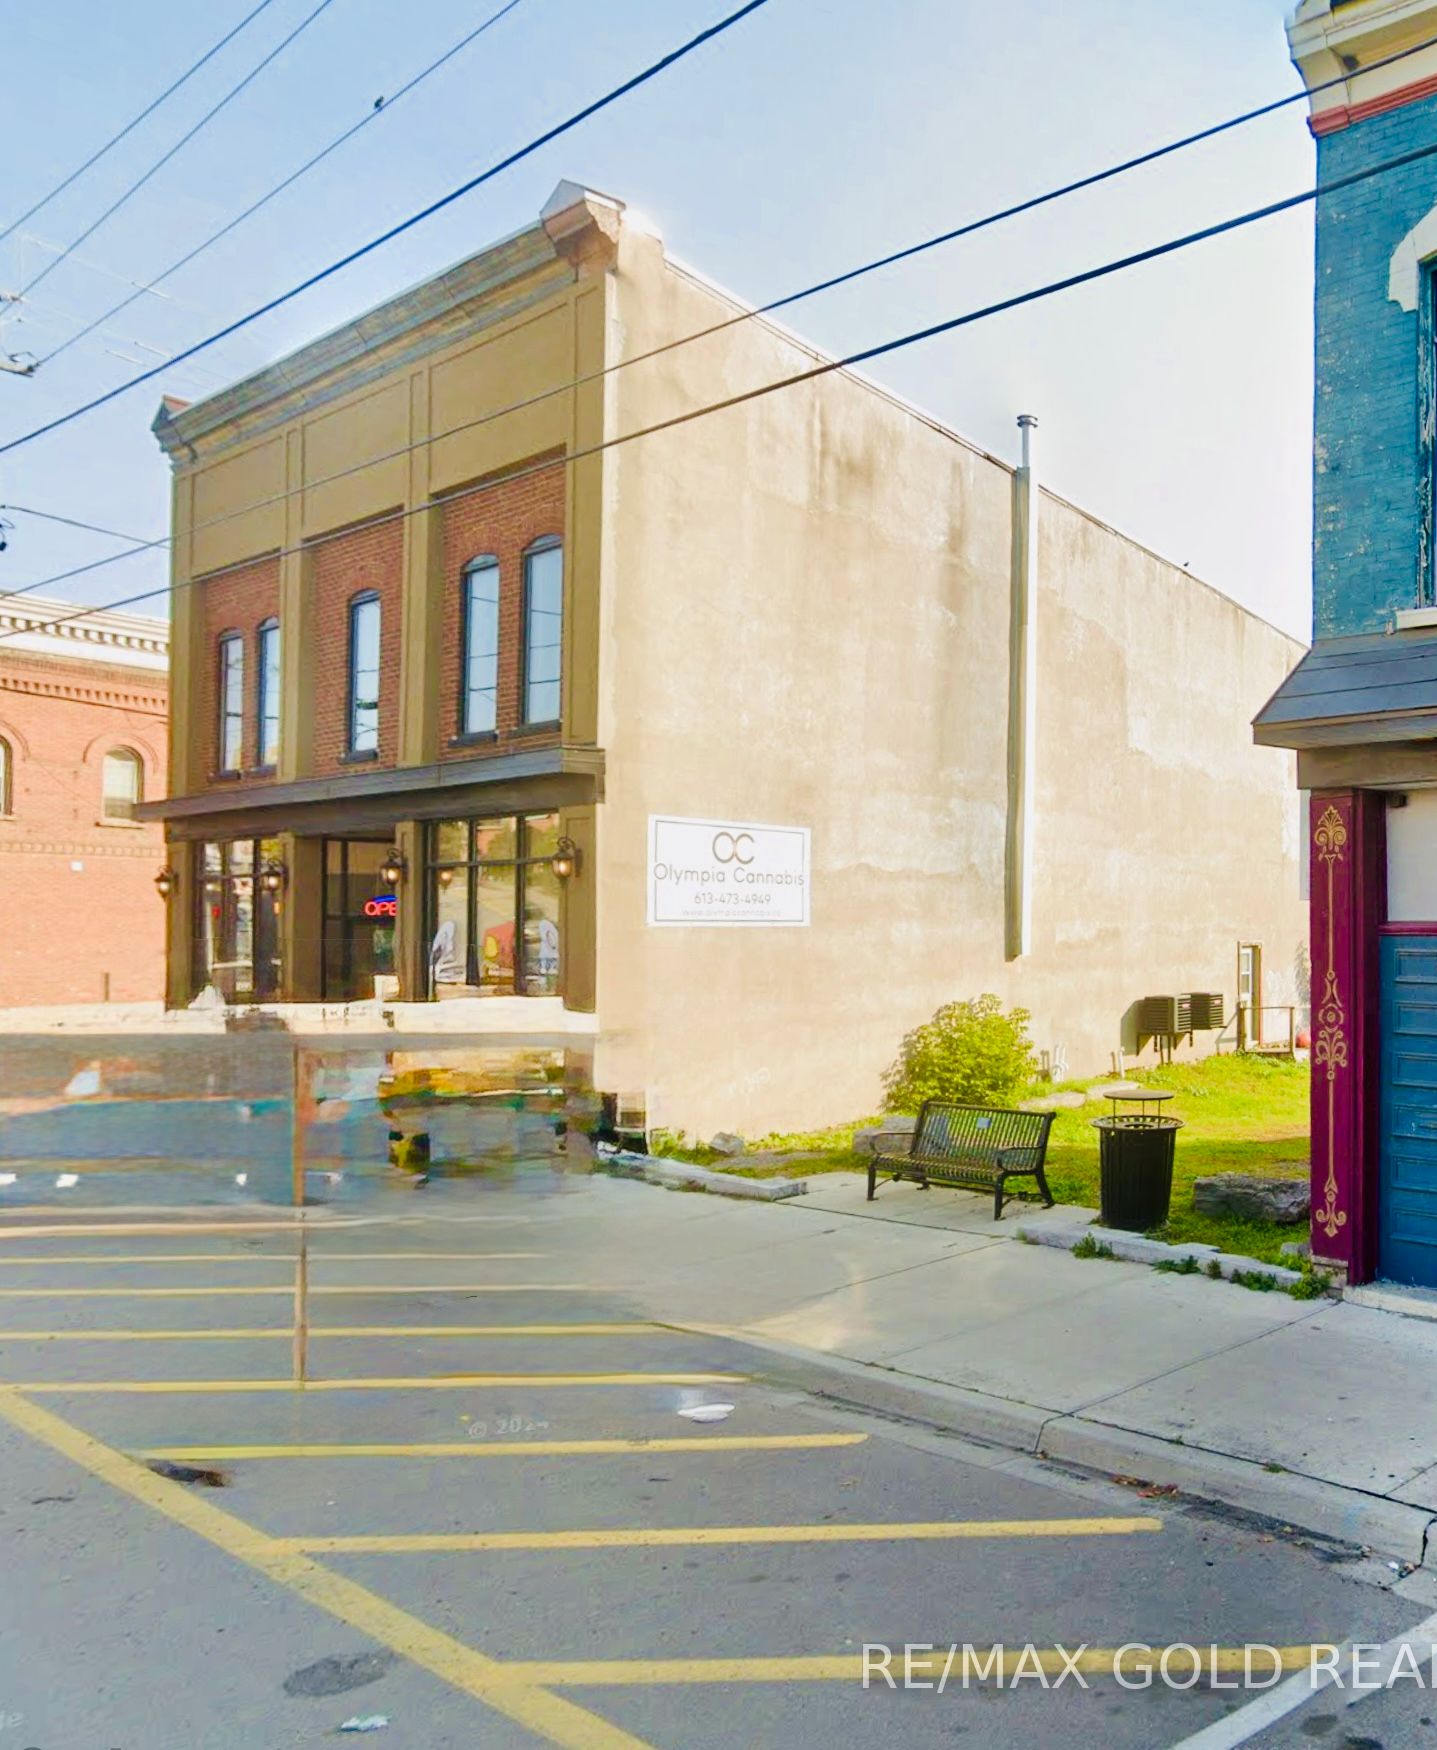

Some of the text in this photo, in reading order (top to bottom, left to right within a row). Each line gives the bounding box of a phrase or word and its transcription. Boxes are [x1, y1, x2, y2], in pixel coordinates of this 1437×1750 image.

[654, 862, 805, 887] Olympia Cannabis
[694, 892, 771, 906] 613-473-4949
